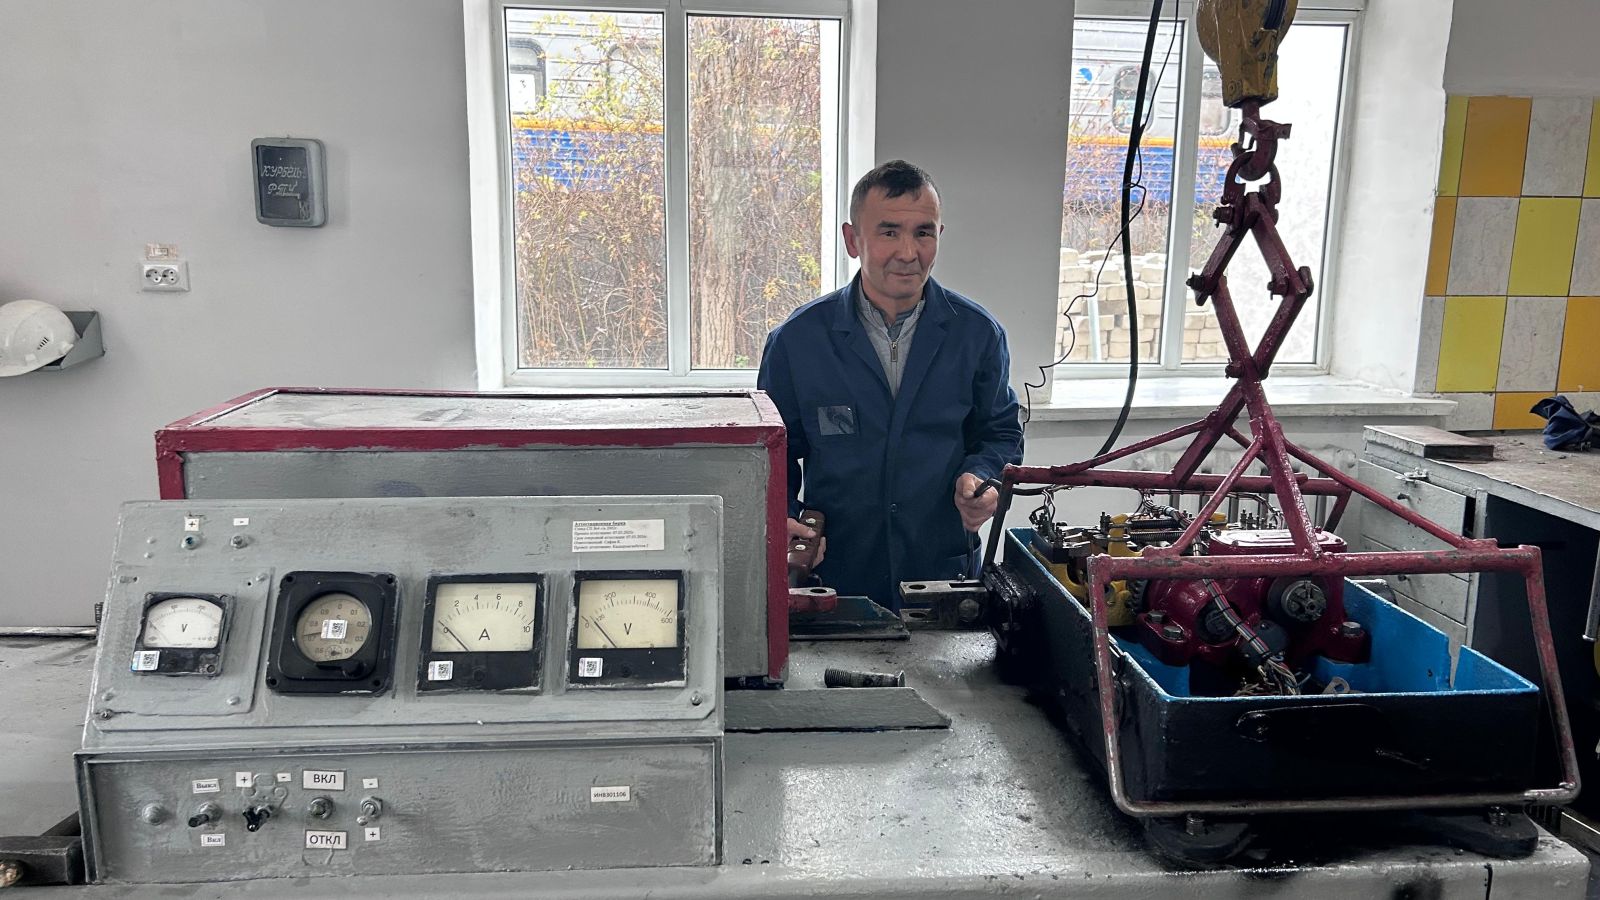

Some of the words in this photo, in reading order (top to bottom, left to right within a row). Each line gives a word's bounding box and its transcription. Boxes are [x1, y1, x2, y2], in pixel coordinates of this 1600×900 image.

[604, 591, 617, 601] 200
[644, 591, 657, 599] 400
[181, 623, 188, 632] V
[624, 623, 632, 635] V
[479, 628, 490, 641] A
[313, 774, 336, 784] ВКЛ
[309, 834, 341, 846] ОТКЛ
